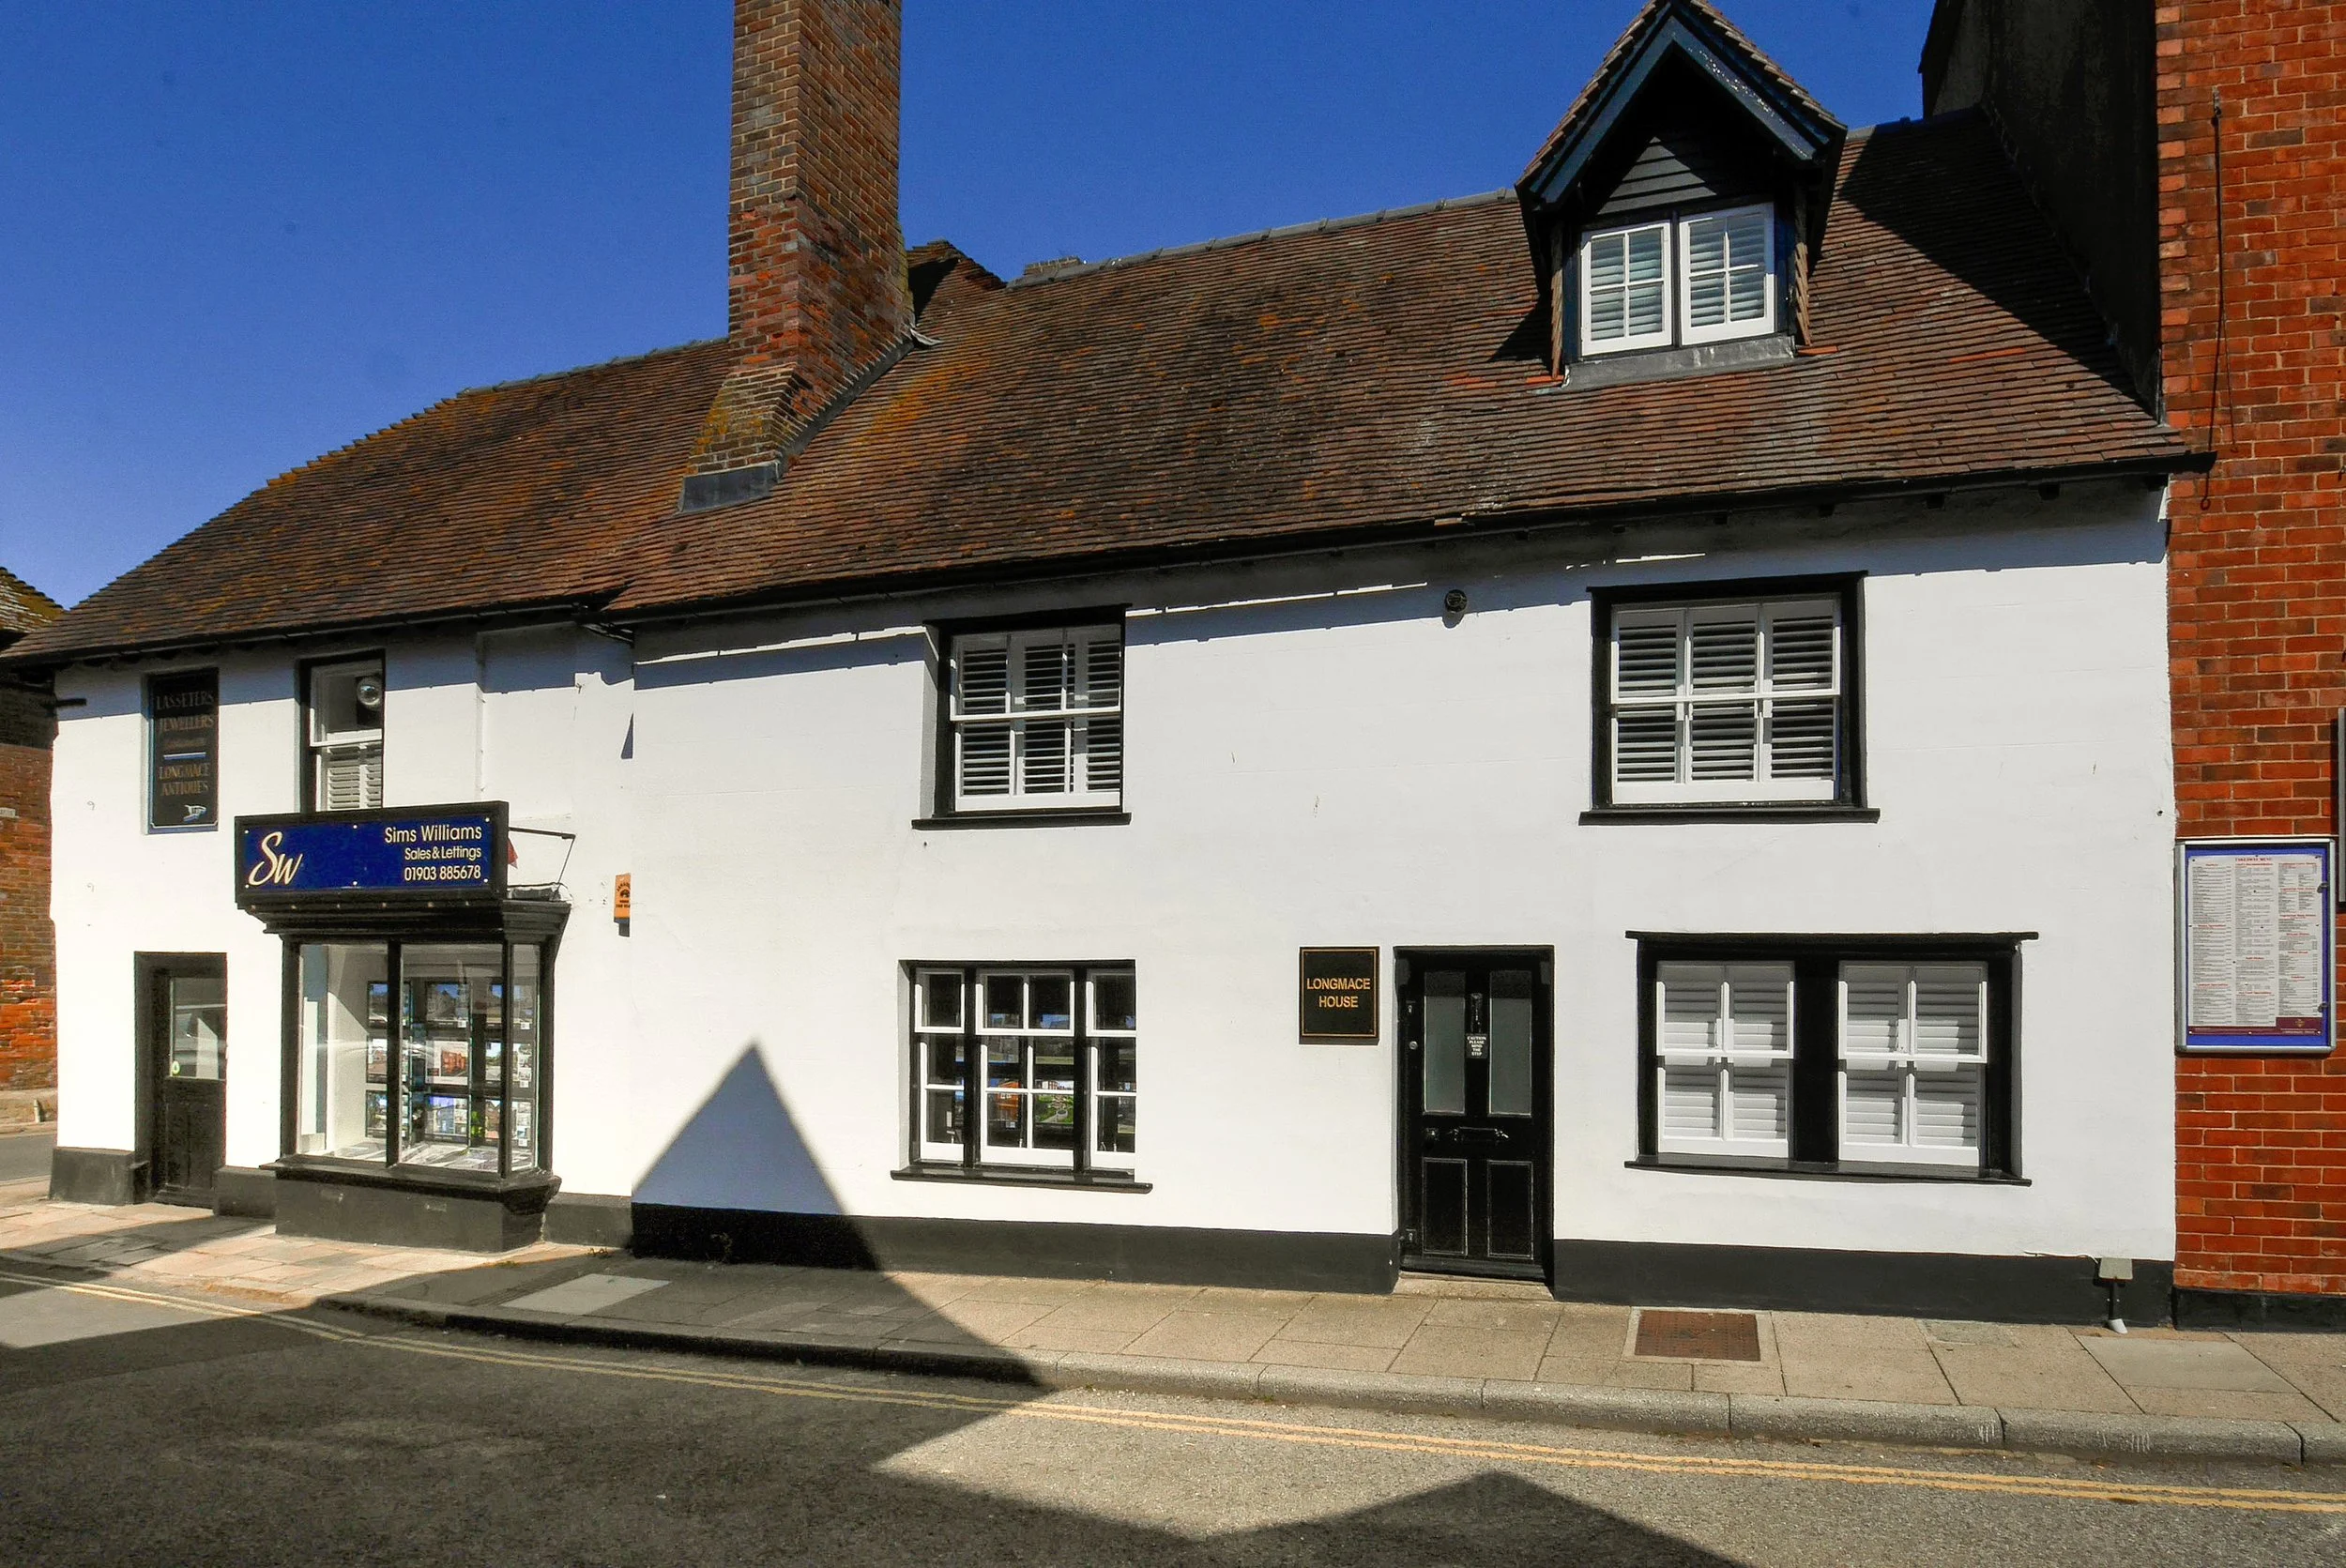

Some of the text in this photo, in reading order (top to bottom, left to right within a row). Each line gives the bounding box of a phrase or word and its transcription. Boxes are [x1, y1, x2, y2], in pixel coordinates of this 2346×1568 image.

[159, 714, 214, 732] JEWELLERS
[159, 763, 210, 780] LONGMACE
[160, 781, 209, 797] ANTIQUES
[385, 824, 482, 844] Sims Williams
[404, 864, 481, 881] 01903 885678
[1306, 978, 1371, 990] LONGMACE
[1318, 996, 1359, 1008] HOUSE
